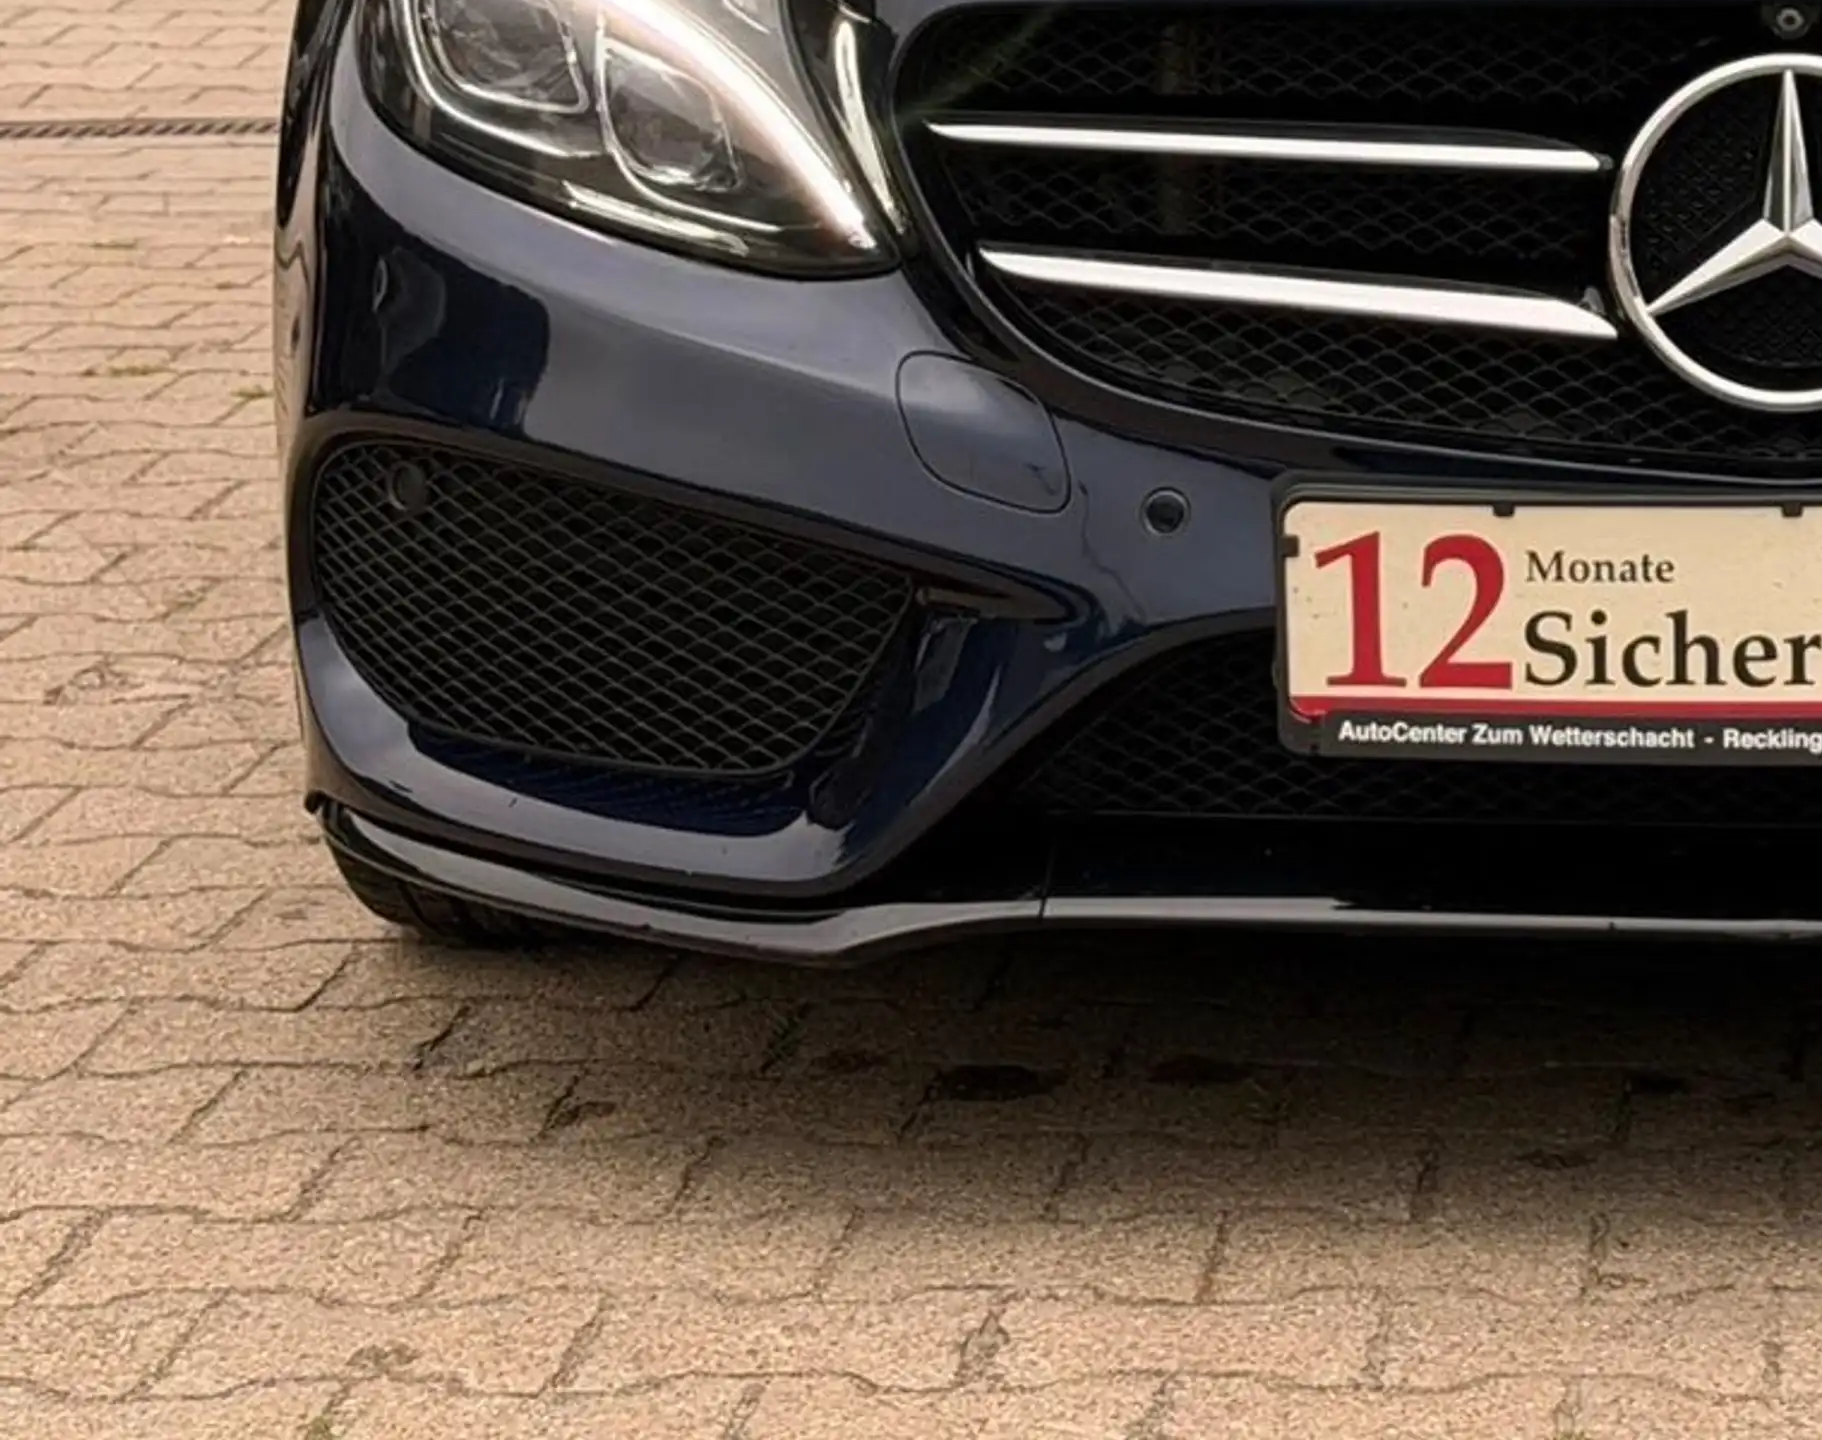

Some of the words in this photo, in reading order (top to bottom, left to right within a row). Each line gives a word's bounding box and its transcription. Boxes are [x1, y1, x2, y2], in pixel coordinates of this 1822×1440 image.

[1525, 550, 1675, 584] Monate
[1315, 531, 1512, 689] 12
[1338, 720, 1467, 744] AutoCenter
[1472, 723, 1523, 745] Zum
[1528, 724, 1694, 749] Wetterschacht
